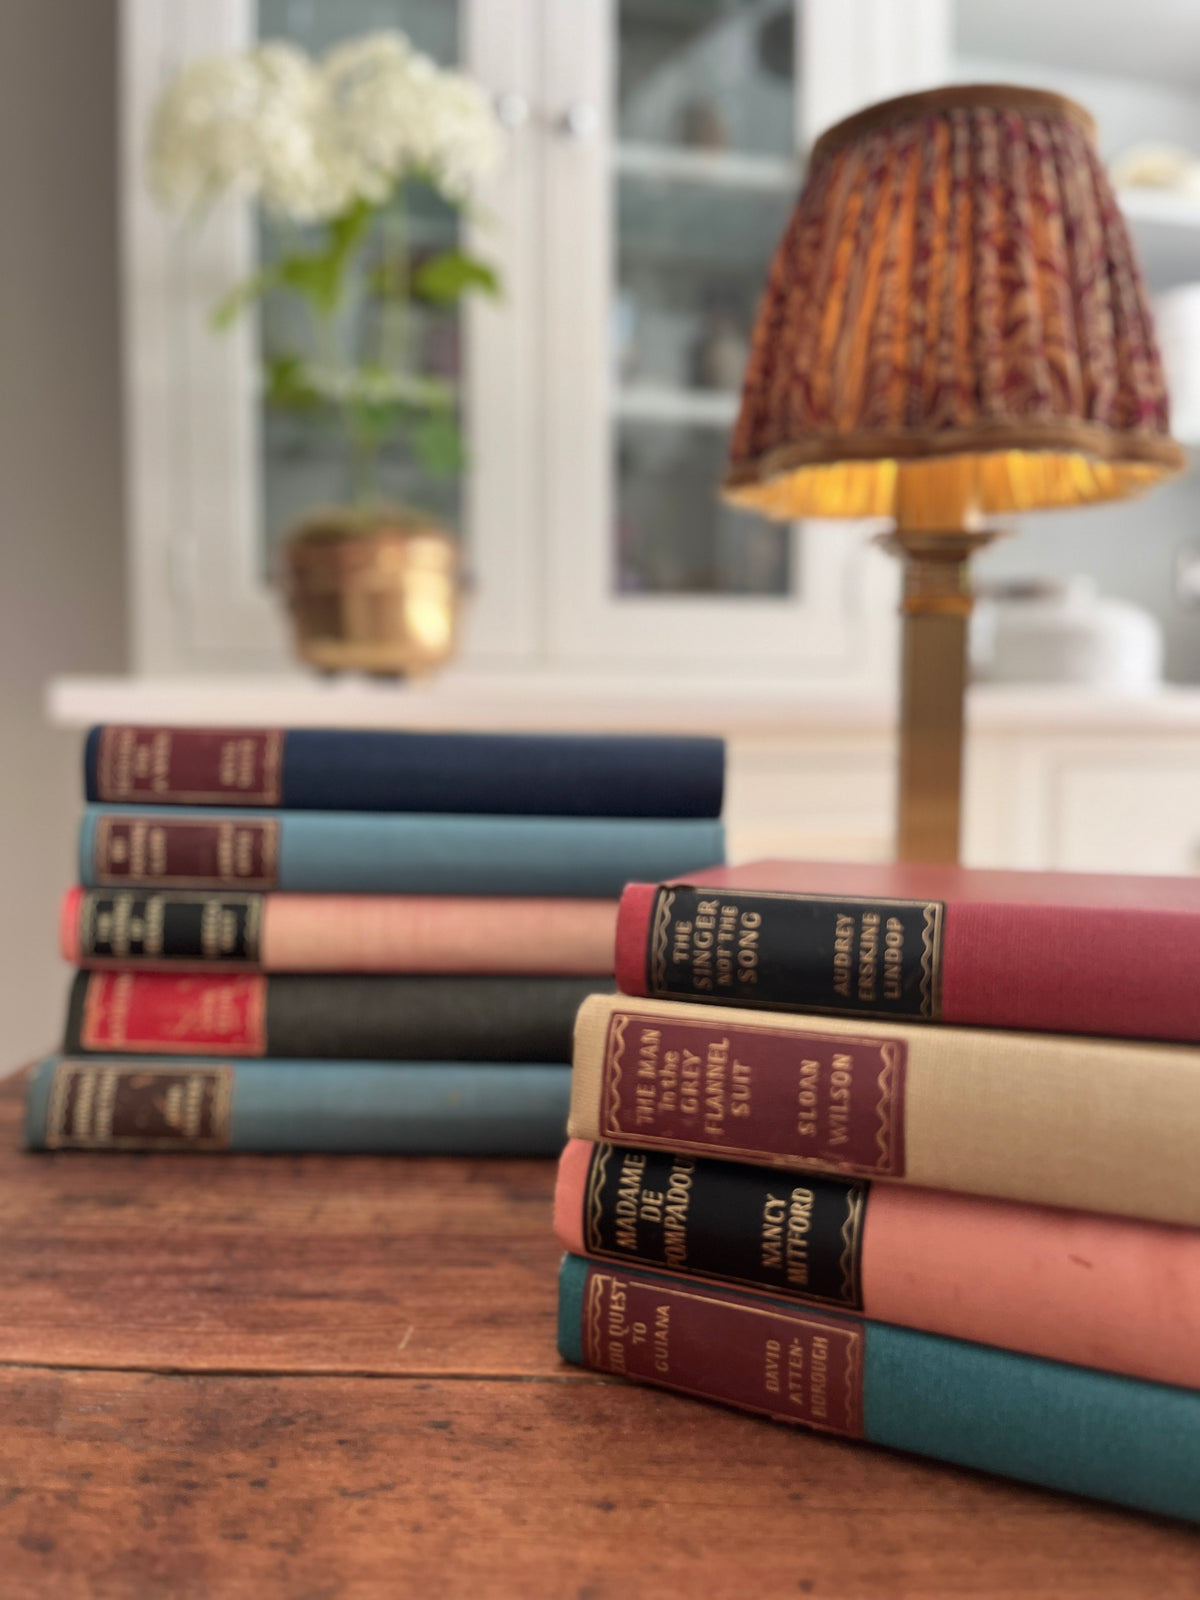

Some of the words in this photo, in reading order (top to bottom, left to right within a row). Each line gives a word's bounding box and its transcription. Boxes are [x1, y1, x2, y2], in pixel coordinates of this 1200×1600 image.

[673, 921, 693, 964] THE
[693, 900, 720, 991] SINGER
[719, 905, 738, 942] THE
[737, 911, 762, 984] SONG
[834, 914, 855, 997] AUDREY
[858, 911, 881, 1000] ERSKINE
[717, 944, 734, 986] NOT
[884, 917, 904, 999] LINDOP
[637, 1029, 662, 1079] MAN
[659, 1051, 680, 1088] the
[681, 1049, 702, 1114] GREY
[704, 1037, 730, 1135] FLANNEL
[731, 1059, 752, 1117] SUIT
[636, 1082, 656, 1125] THE
[798, 1059, 820, 1137] SLOAN
[829, 1053, 853, 1146] WILSON
[615, 1153, 647, 1250] MADAME
[640, 1189, 664, 1224] DE
[761, 1193, 787, 1269] NANCY
[786, 1187, 815, 1285] MITFORD
[608, 1277, 629, 1337] QUEST
[632, 1321, 648, 1345] TO
[654, 1305, 671, 1373] GUIANA
[765, 1339, 781, 1393] DAVID
[787, 1337, 804, 1405] ATTEN-
[811, 1336, 829, 1418] BOROUGH
